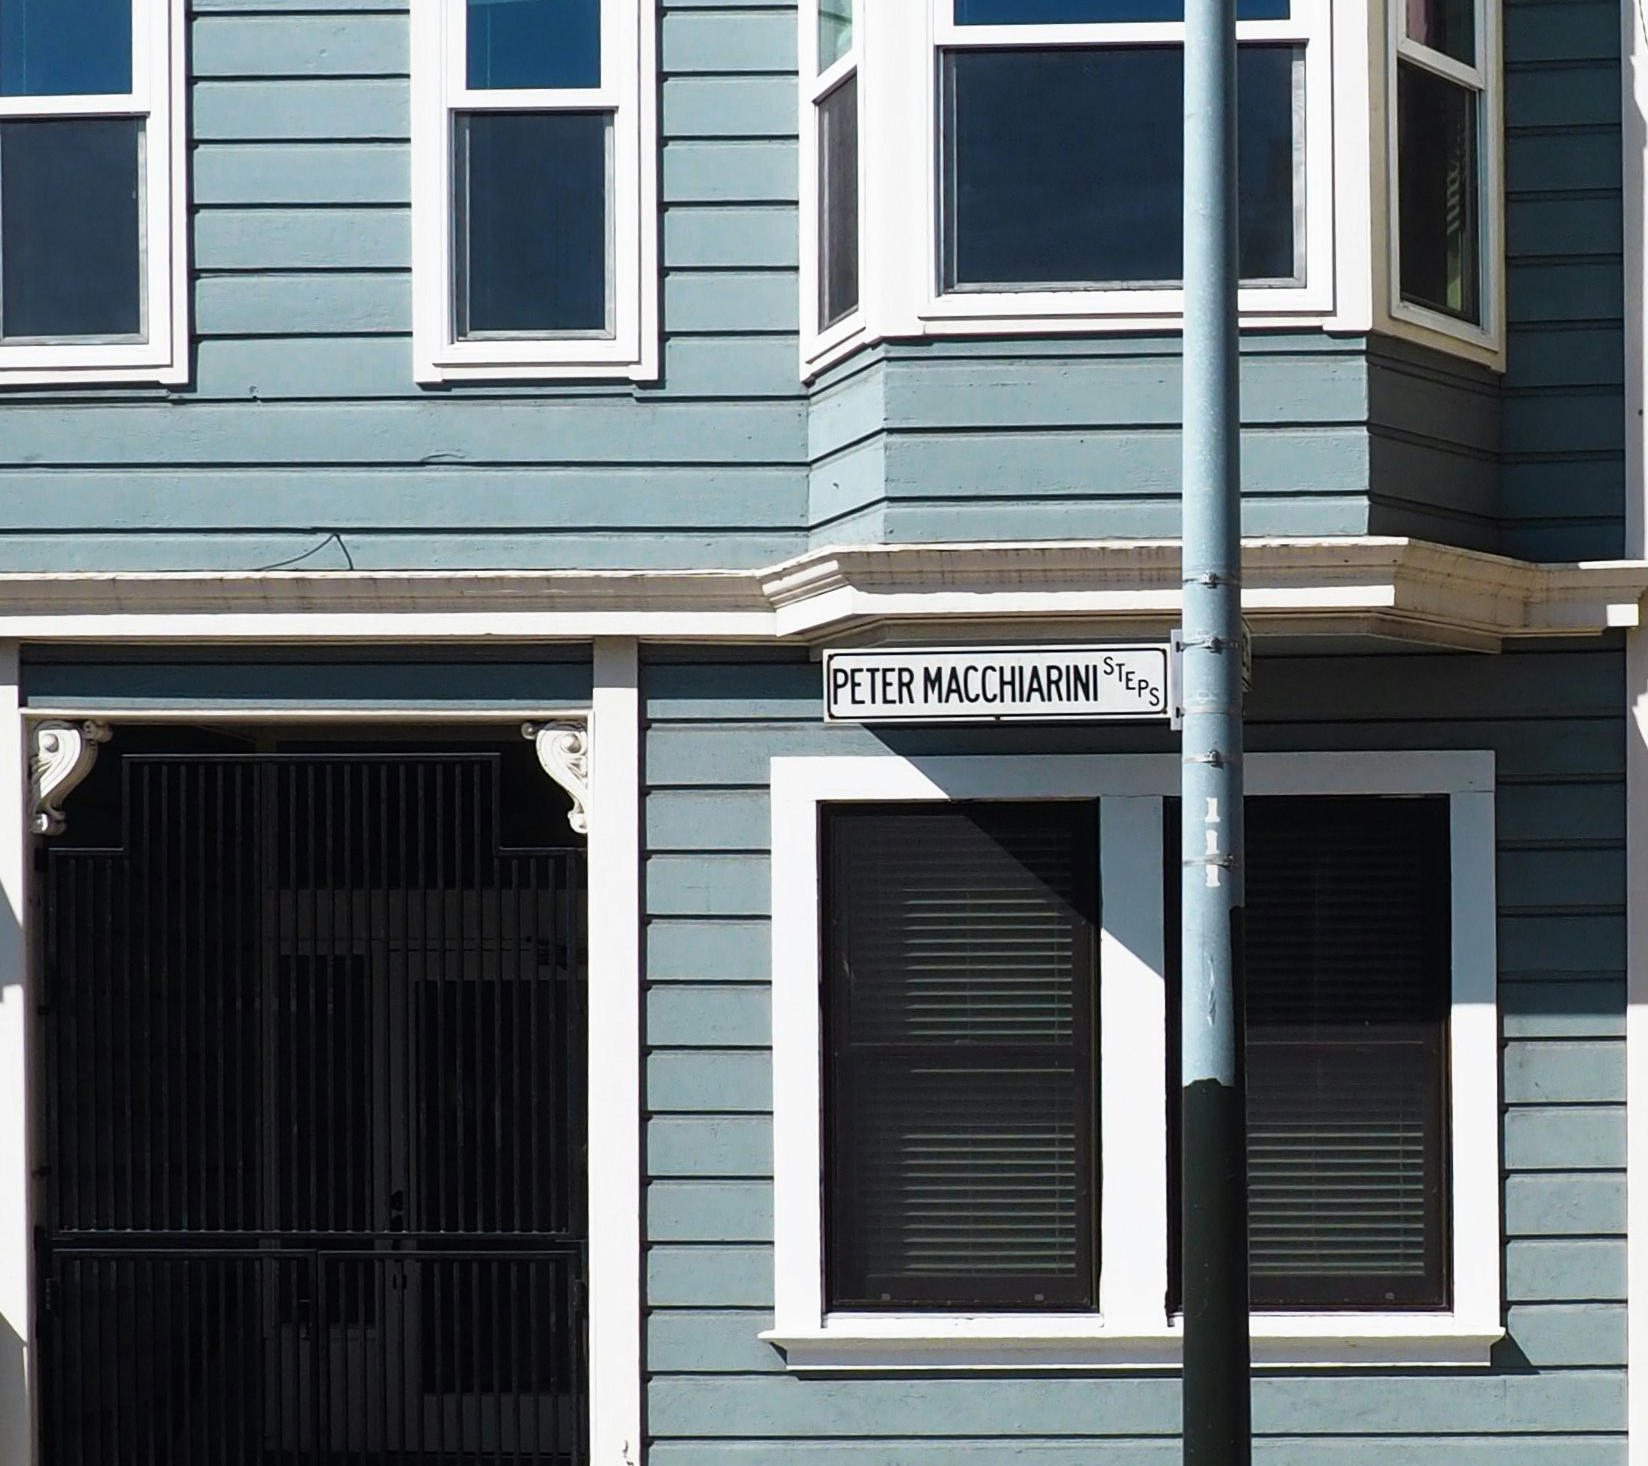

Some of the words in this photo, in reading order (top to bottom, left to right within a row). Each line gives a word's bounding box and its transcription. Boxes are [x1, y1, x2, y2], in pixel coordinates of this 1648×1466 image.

[832, 667, 915, 706] PETER
[923, 664, 1099, 704] MACCHIARINI
[1103, 656, 1160, 707] STEPS
